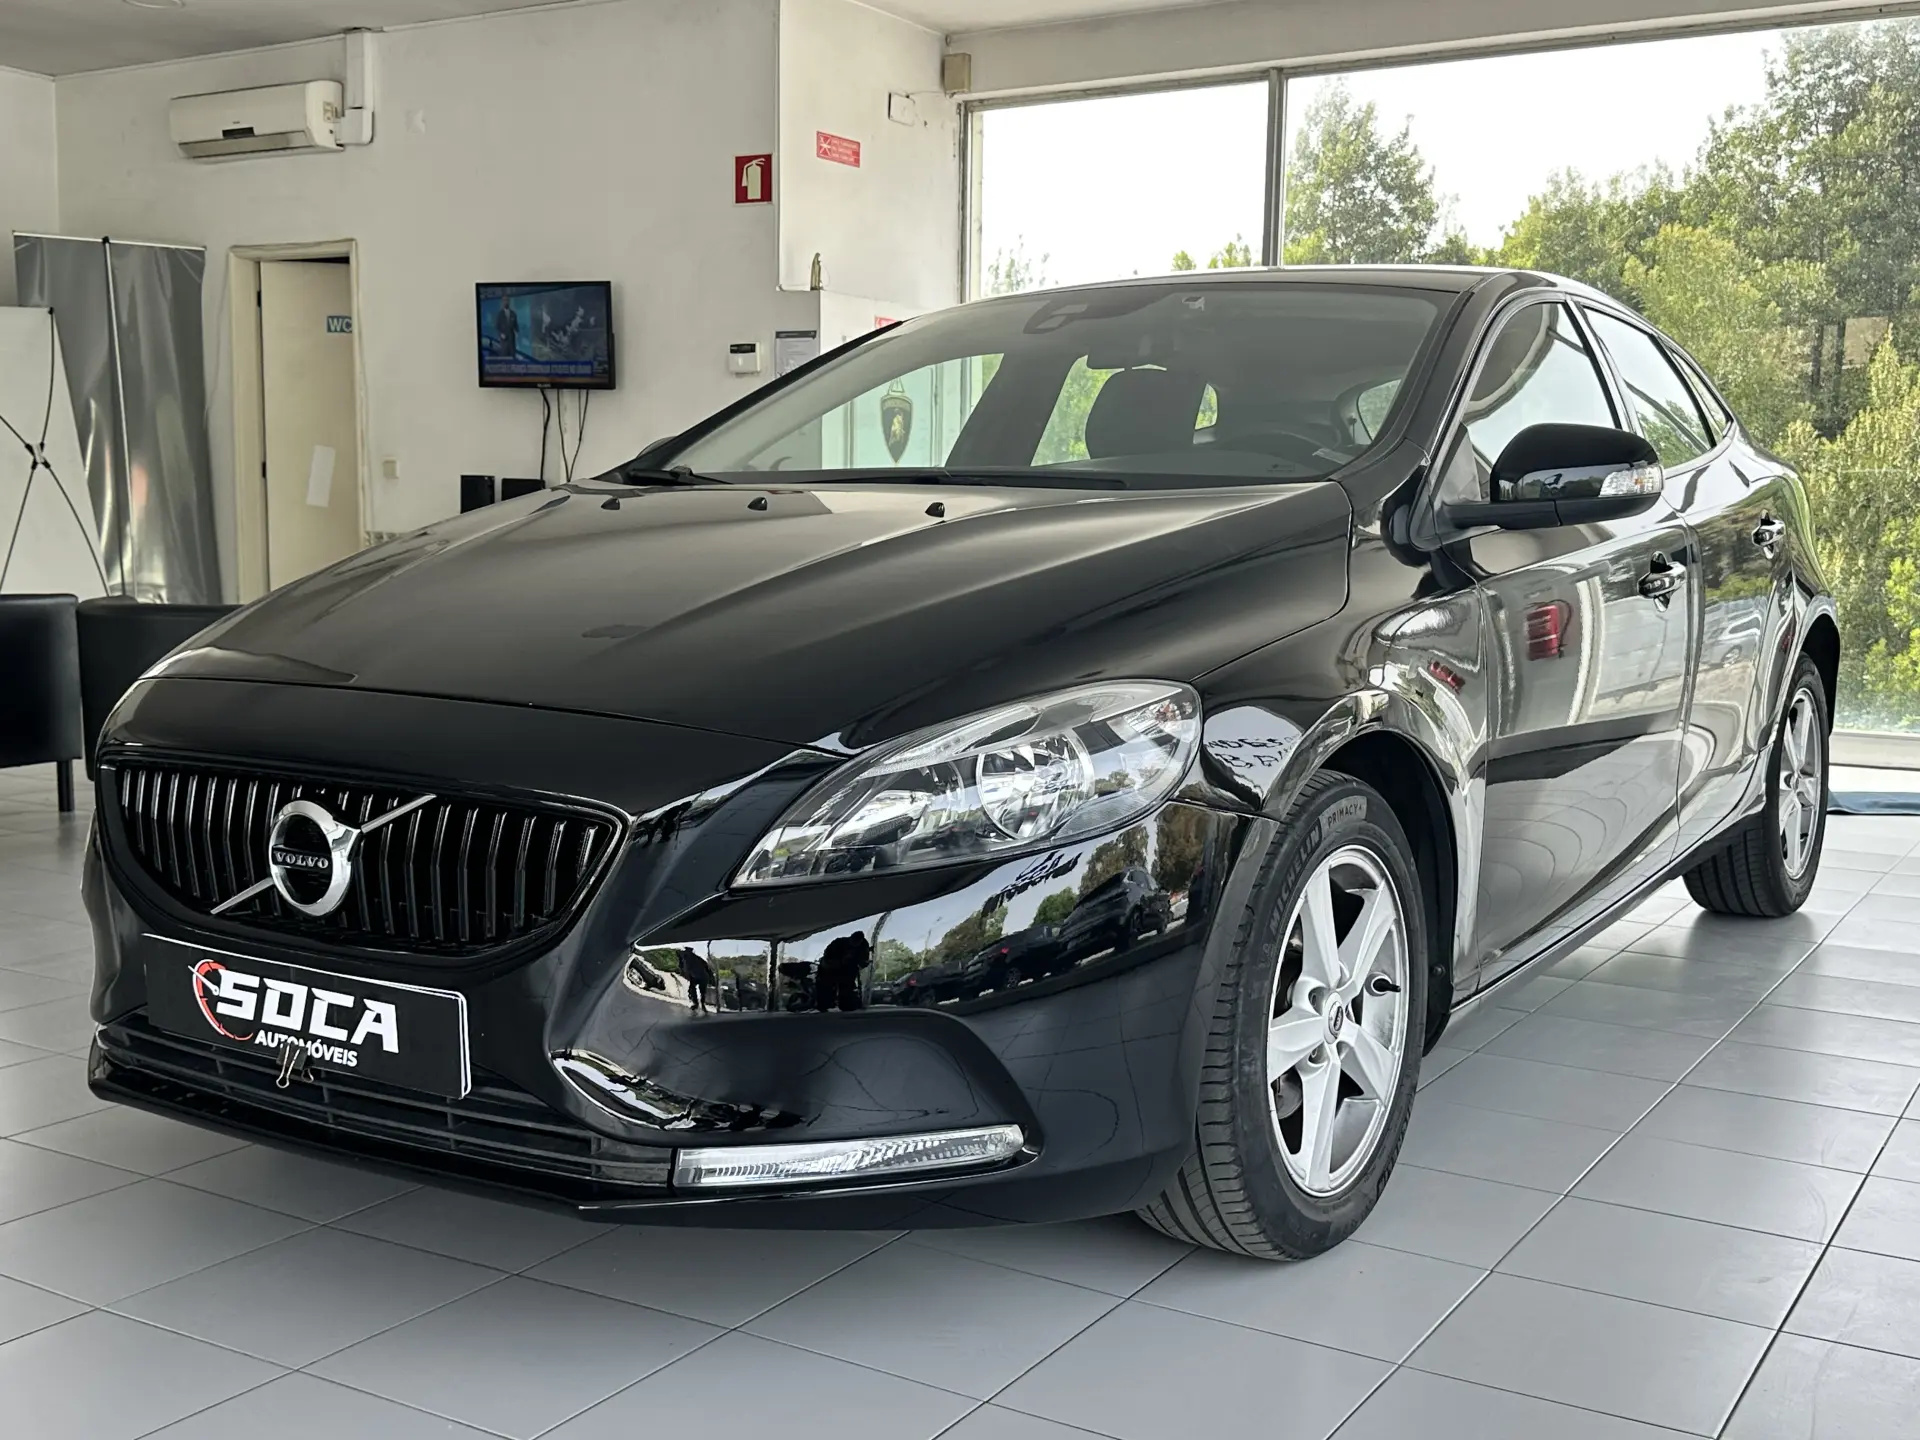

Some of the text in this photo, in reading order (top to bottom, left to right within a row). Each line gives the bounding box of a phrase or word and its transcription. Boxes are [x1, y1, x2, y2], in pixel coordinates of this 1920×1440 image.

[328, 317, 352, 332] WC
[1327, 803, 1358, 829] PRIMACY
[273, 850, 329, 869] VOLVO
[1268, 825, 1320, 935] MICHELIN
[216, 969, 399, 1054] SOCA
